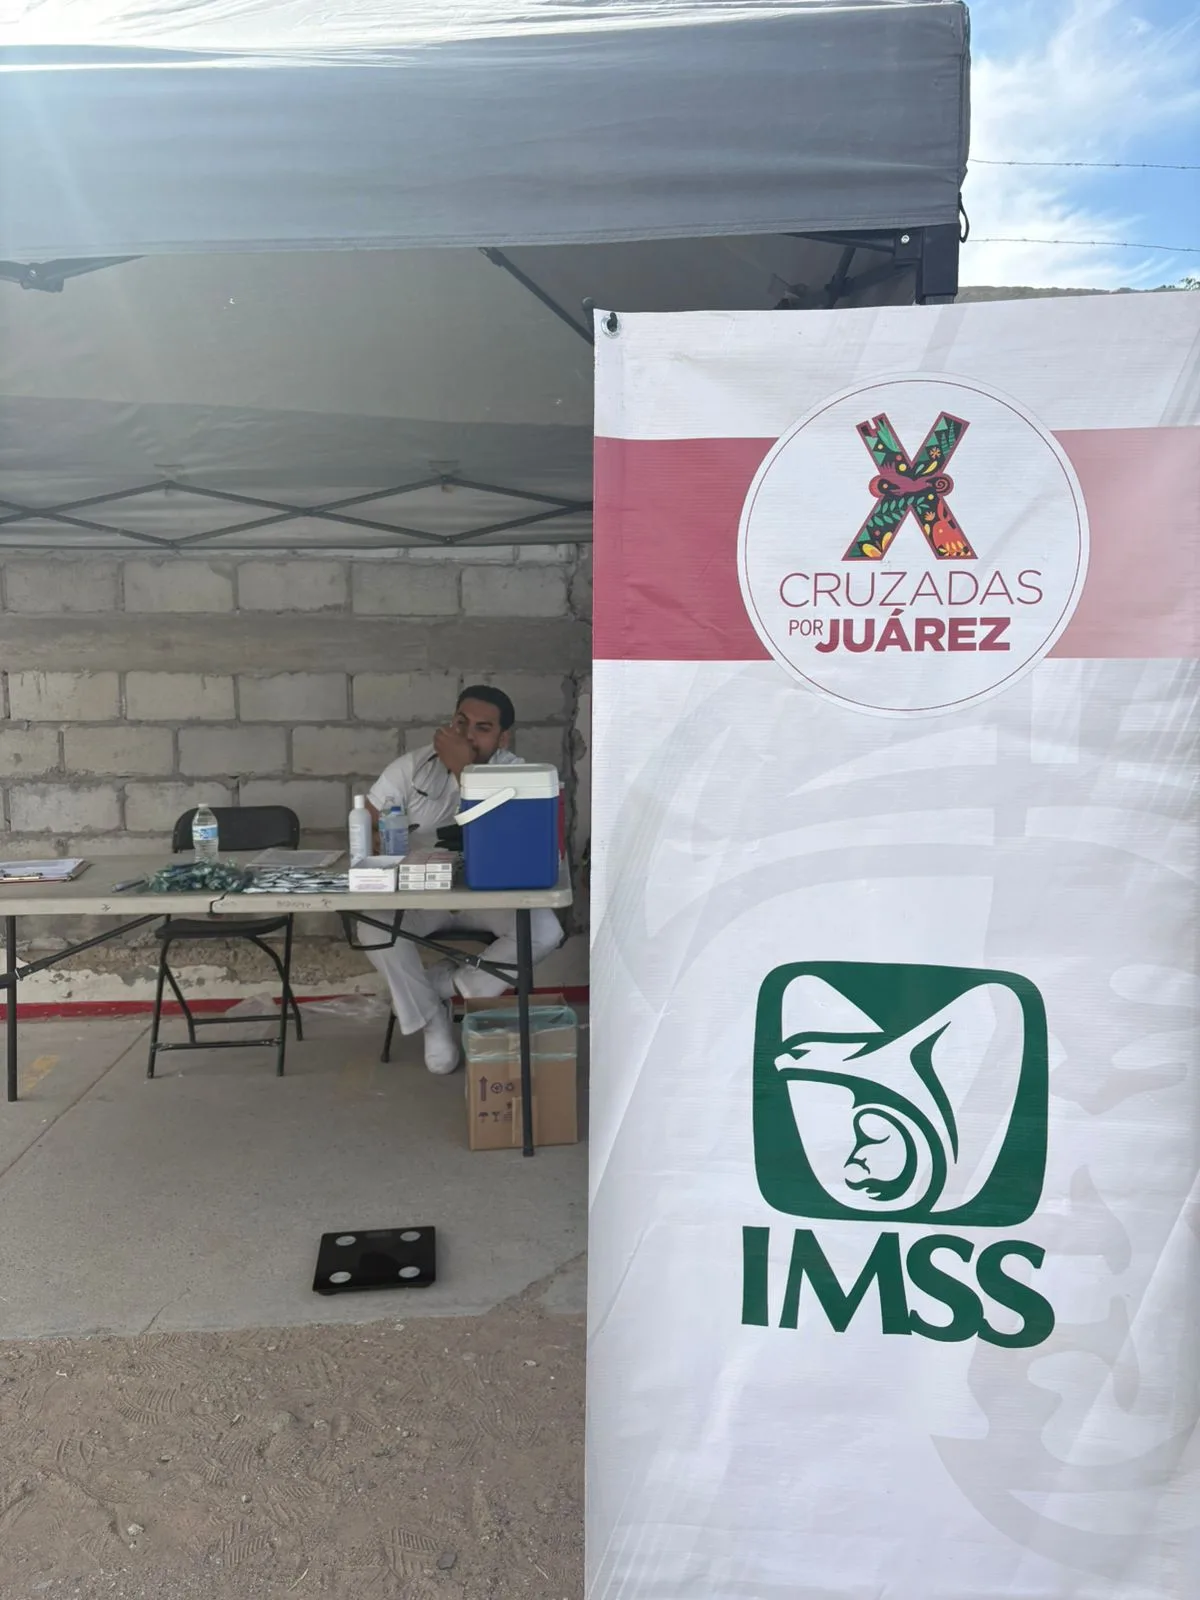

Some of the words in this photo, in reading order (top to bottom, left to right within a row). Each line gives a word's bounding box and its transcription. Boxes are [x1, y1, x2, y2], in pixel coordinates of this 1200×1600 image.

[779, 570, 1043, 607] CRUZADAS
[789, 619, 823, 636] POR
[814, 608, 1011, 653] JUÁREZ
[741, 1226, 1054, 1348] IMSS
